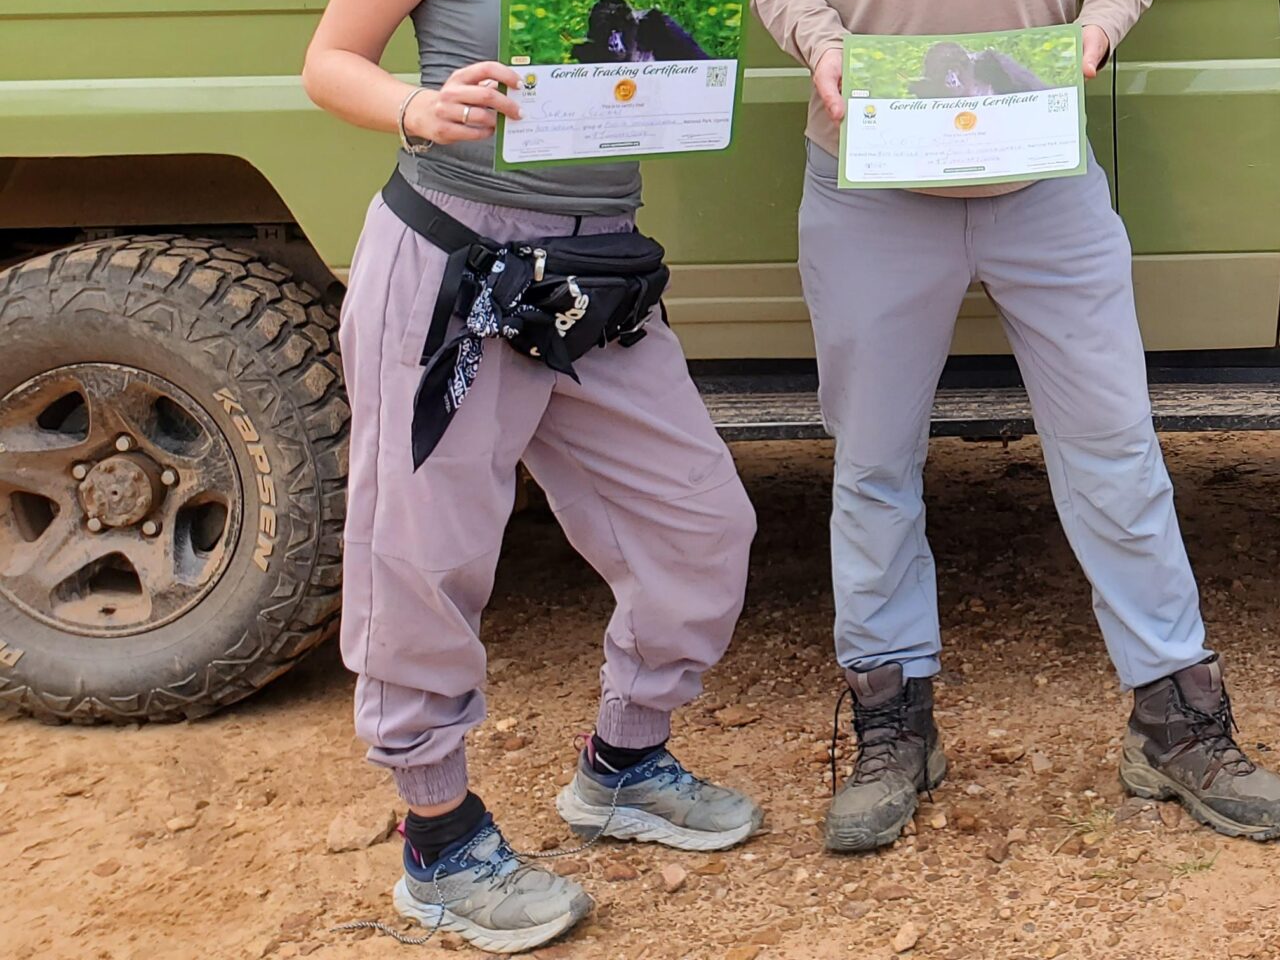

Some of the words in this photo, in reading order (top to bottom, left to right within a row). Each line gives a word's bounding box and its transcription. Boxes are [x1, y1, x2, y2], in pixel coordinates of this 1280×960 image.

[550, 67, 589, 79] Gorilla
[592, 66, 639, 78] Tracking
[641, 64, 699, 76] Certificate
[889, 100, 928, 111] Gorilla
[931, 98, 979, 111] Tracking
[982, 94, 1039, 108] Certificate
